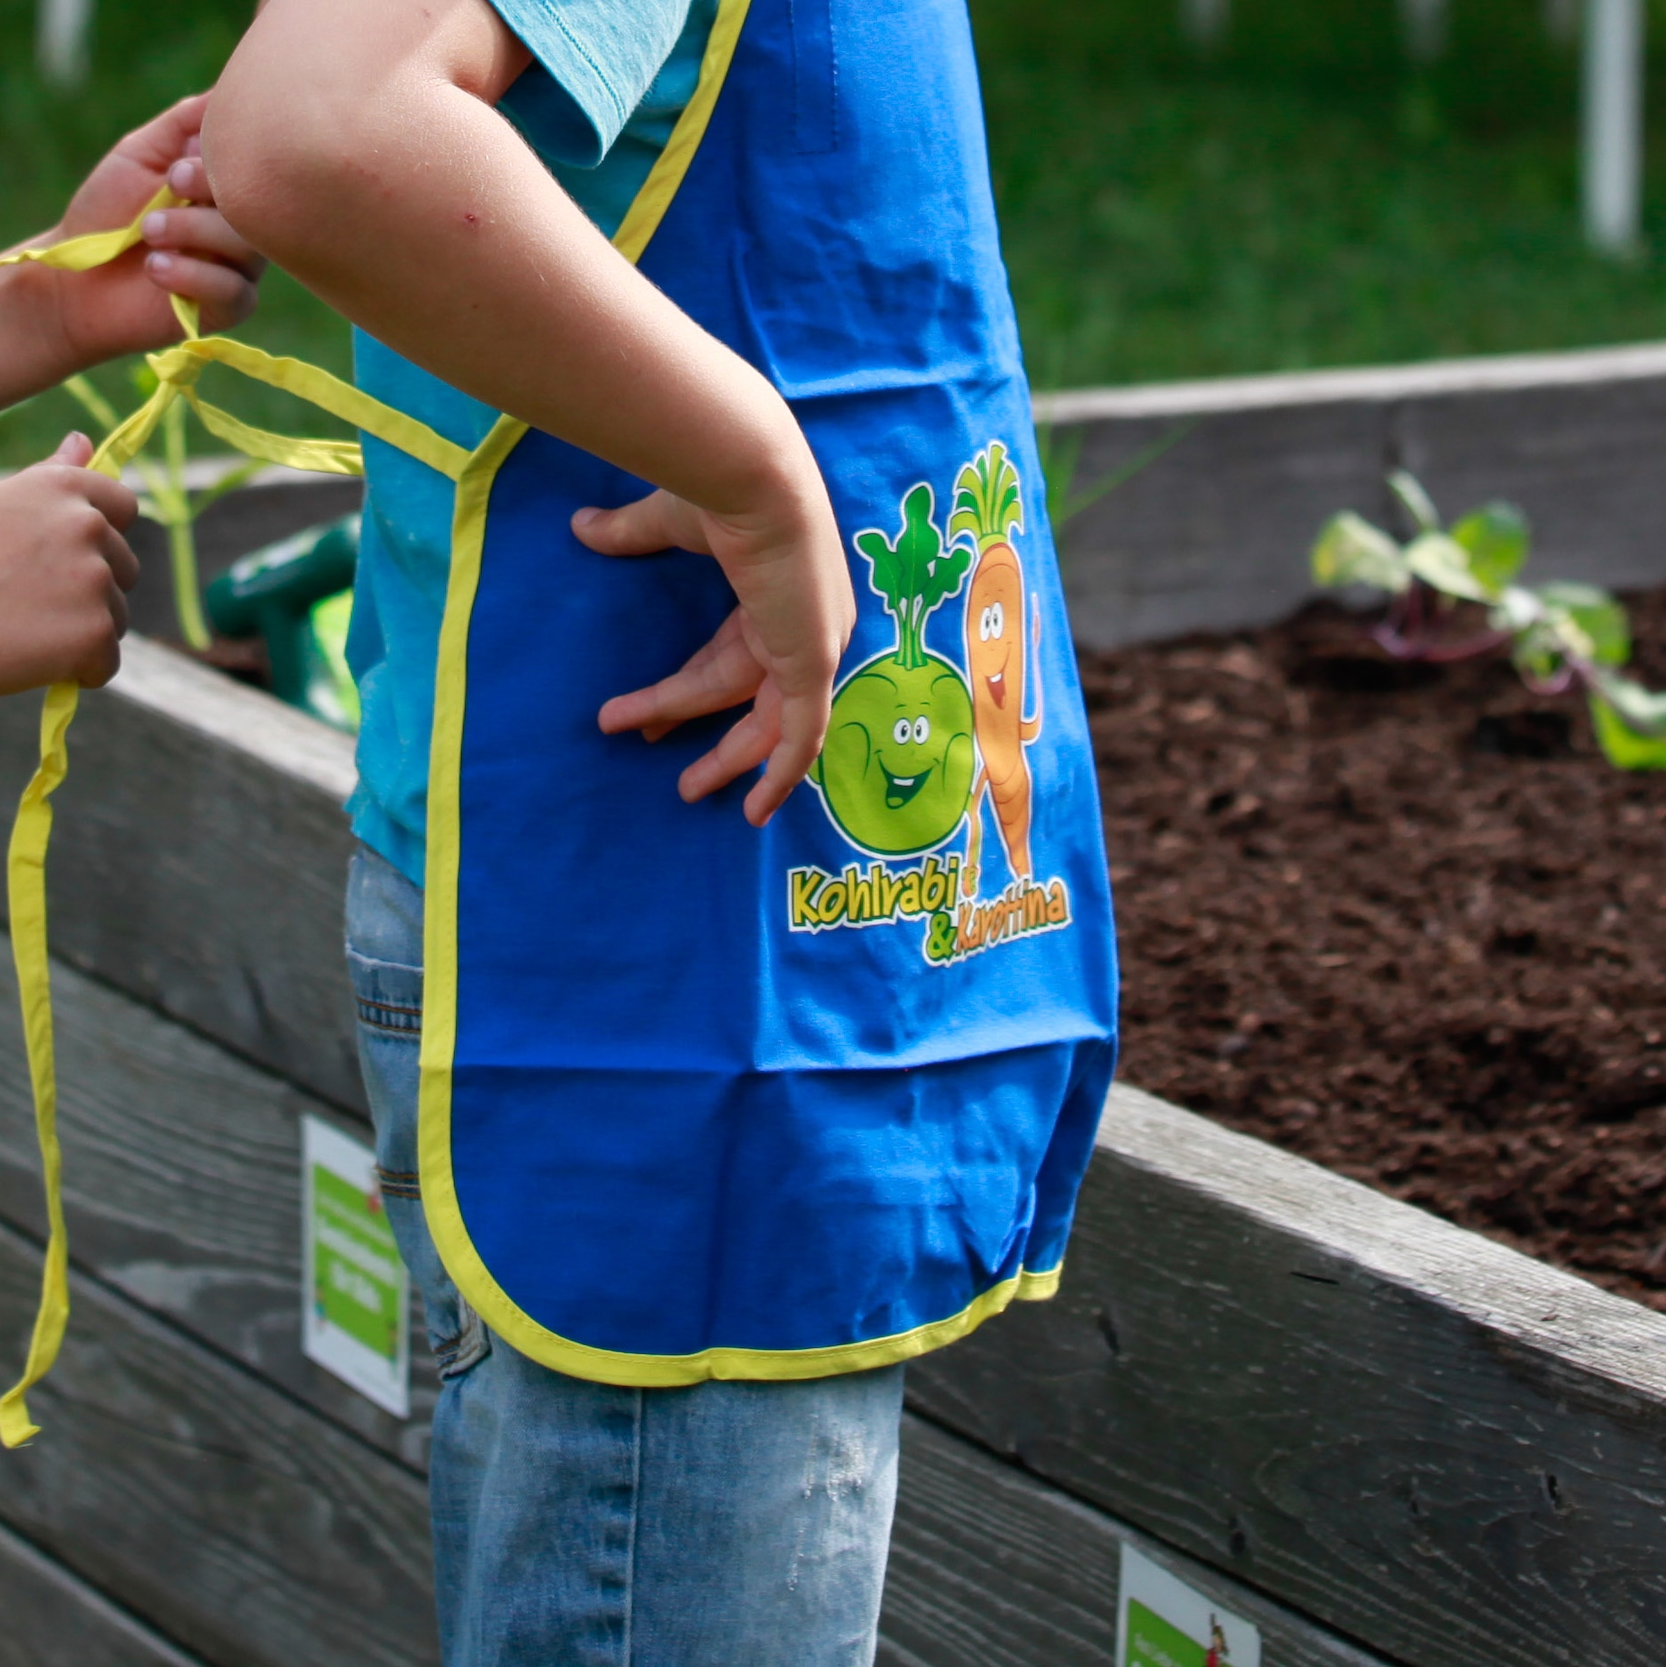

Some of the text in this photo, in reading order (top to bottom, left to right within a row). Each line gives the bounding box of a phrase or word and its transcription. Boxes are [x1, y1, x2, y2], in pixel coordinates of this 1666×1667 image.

[791, 855, 960, 926] Kohlrabi
[926, 880, 1067, 961] & Karottina
